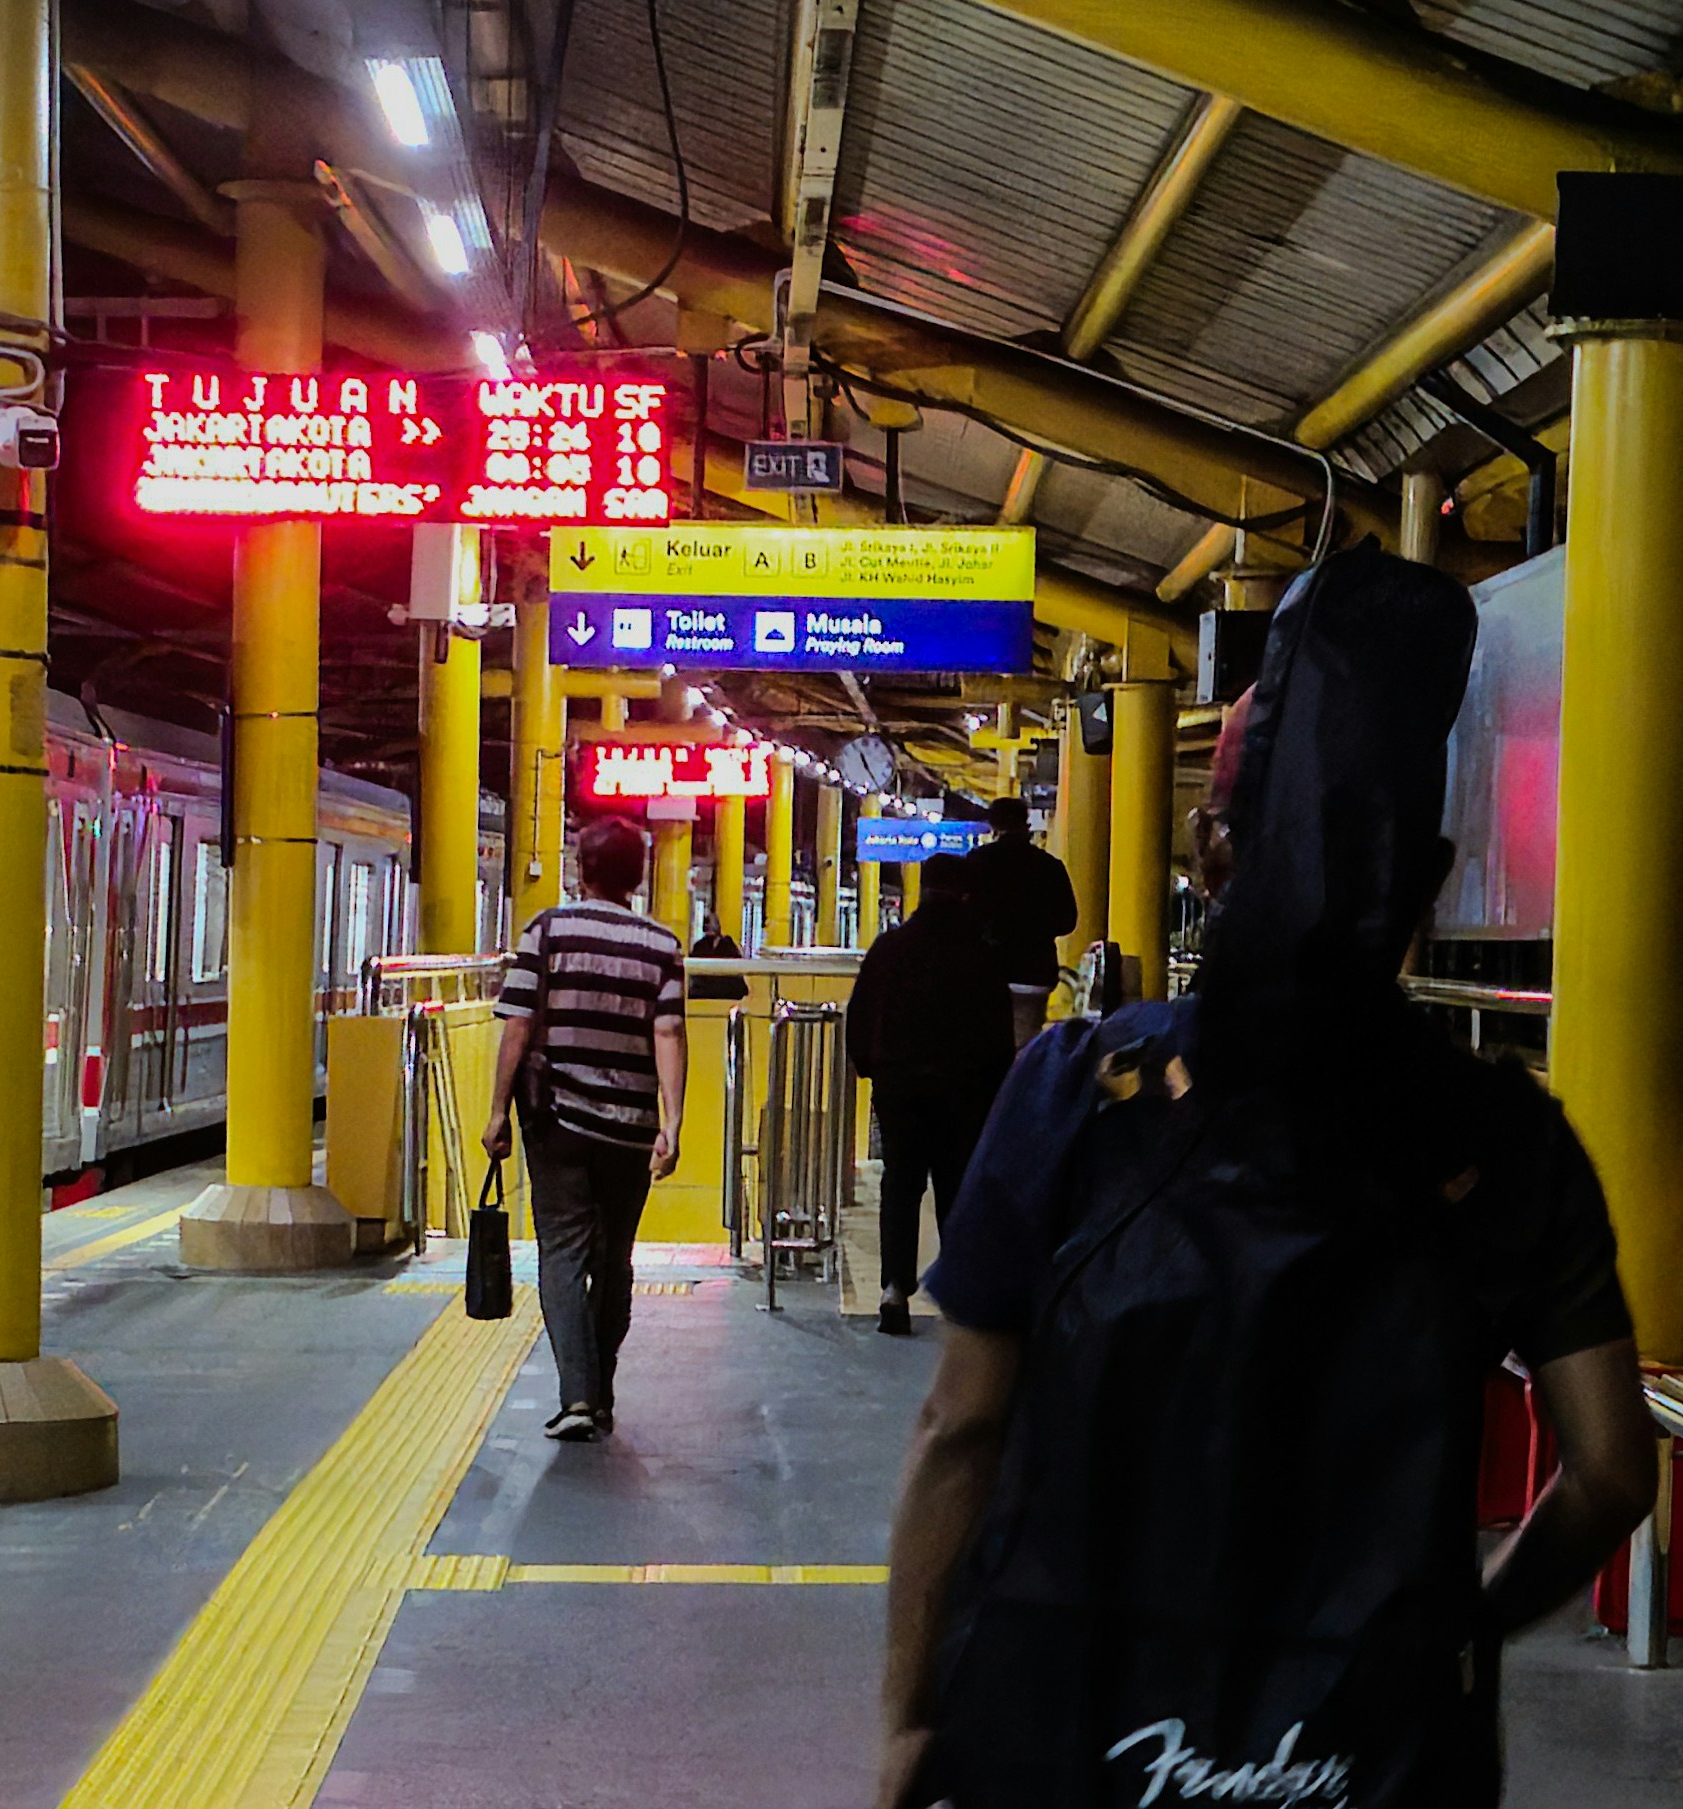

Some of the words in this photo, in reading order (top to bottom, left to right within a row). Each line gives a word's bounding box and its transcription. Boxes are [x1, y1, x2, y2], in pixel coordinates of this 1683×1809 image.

[478, 382, 605, 418] WAKTU
[614, 384, 667, 419] SF
[616, 421, 661, 453] 10
[616, 455, 661, 486] 10
[754, 453, 802, 478] EXIT
[667, 540, 732, 558] Keluar
[755, 552, 769, 568] A
[805, 552, 816, 568] B
[667, 562, 693, 576] Exit
[666, 610, 726, 632] Toilet
[806, 612, 882, 635] Musala
[666, 635, 734, 652] Restroom
[805, 637, 861, 656] Praying
[862, 638, 904, 654] Room
